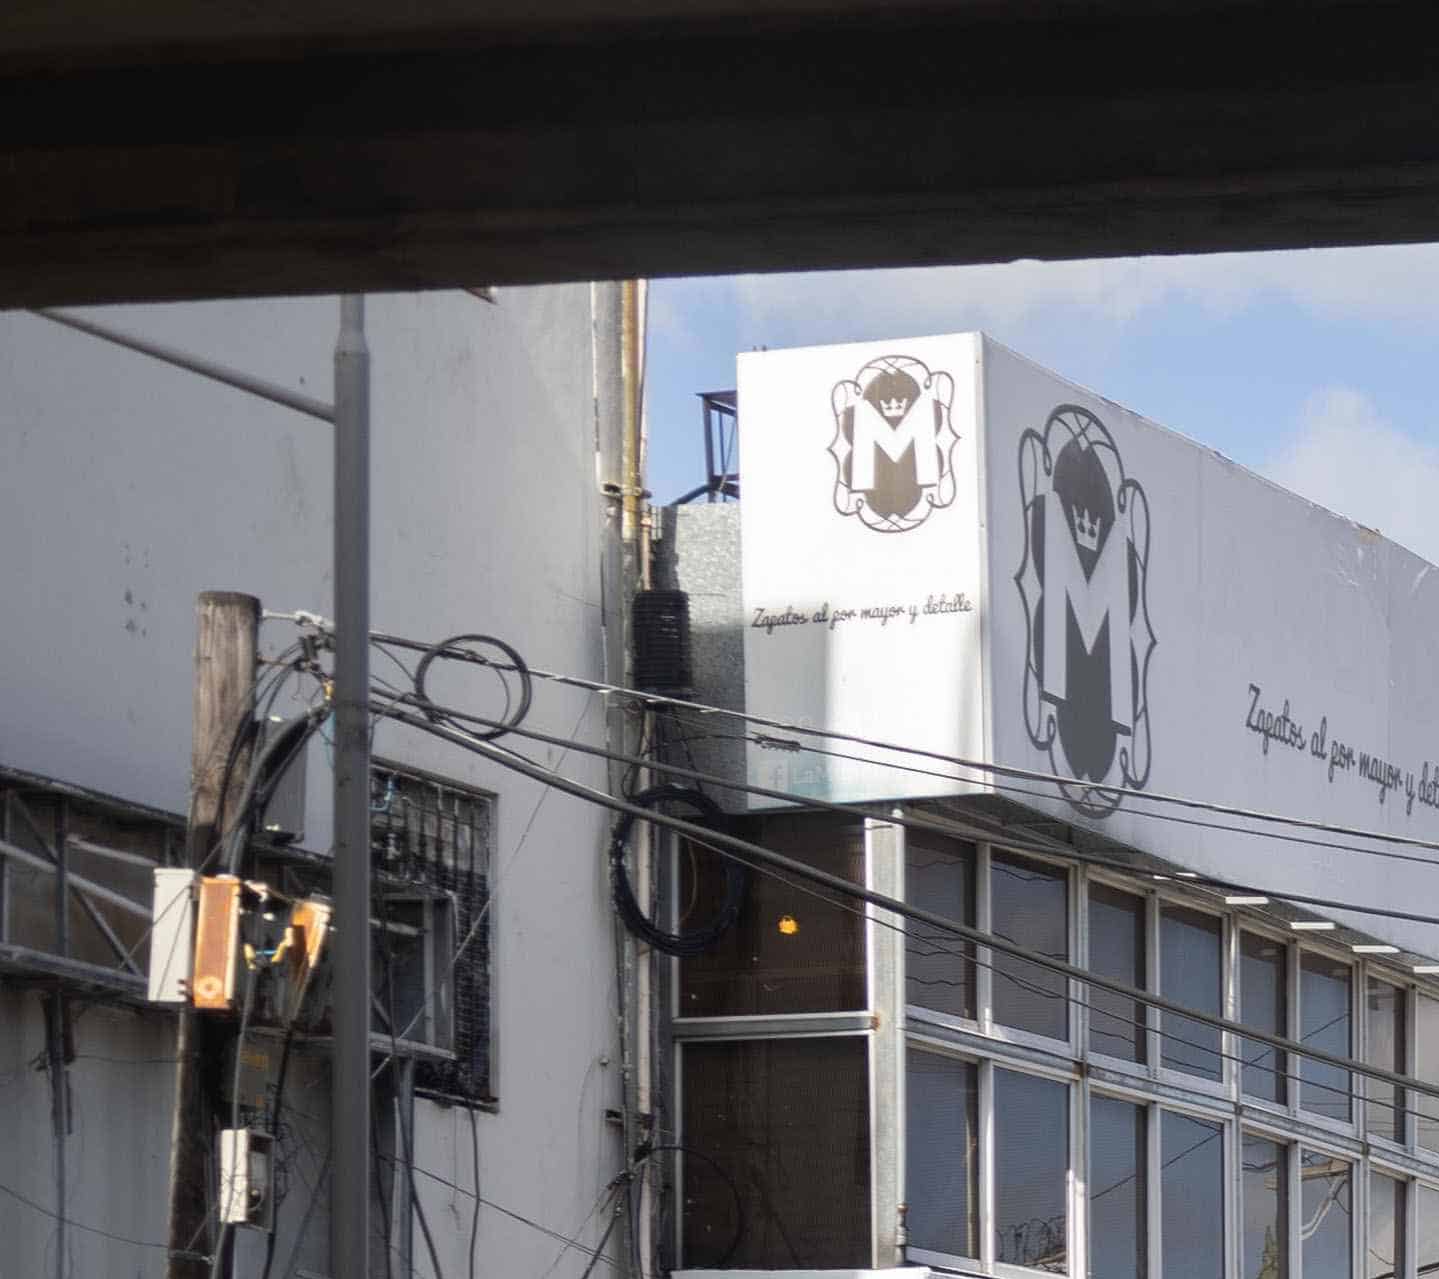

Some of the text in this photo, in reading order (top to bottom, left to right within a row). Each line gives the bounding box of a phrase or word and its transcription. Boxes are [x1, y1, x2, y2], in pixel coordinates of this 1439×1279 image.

[751, 593, 973, 634] Zapatos al por mayor y detalle
[1246, 683, 1306, 755] Zapatos
[1311, 716, 1327, 760] al
[1328, 740, 1356, 783] por
[1359, 751, 1403, 805] mayor
[1405, 772, 1416, 817] y
